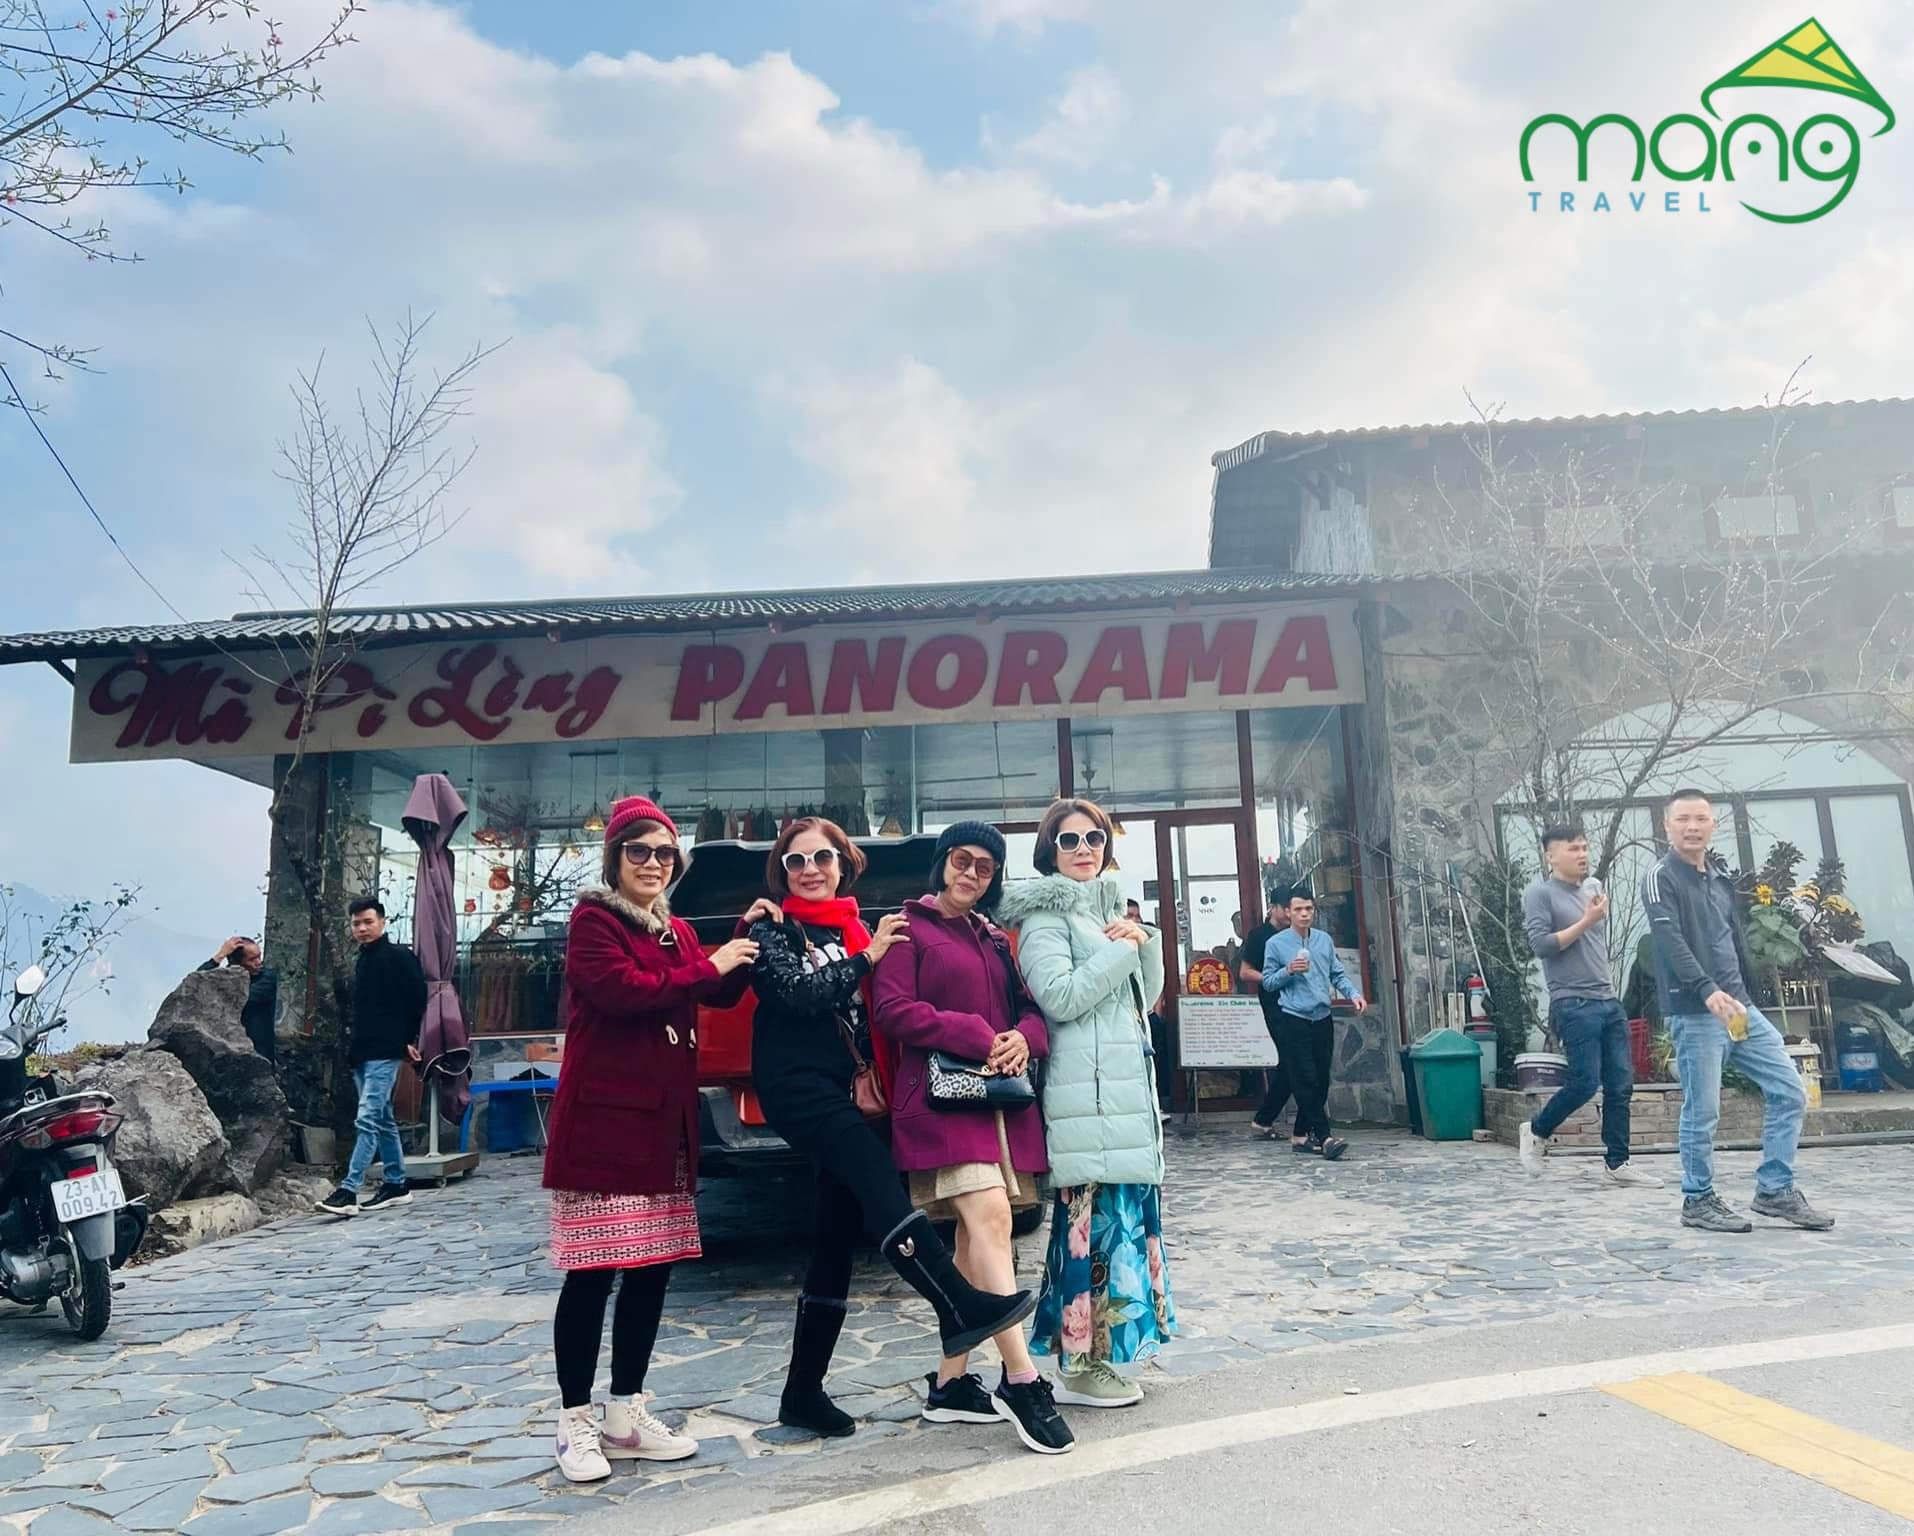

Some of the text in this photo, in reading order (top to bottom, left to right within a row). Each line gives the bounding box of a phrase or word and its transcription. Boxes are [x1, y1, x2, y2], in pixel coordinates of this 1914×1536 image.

[408, 642, 622, 741] Lèng
[669, 615, 1339, 722] PANORAMA
[63, 1174, 109, 1200] 23-AY
[61, 1191, 120, 1218] 009.42
